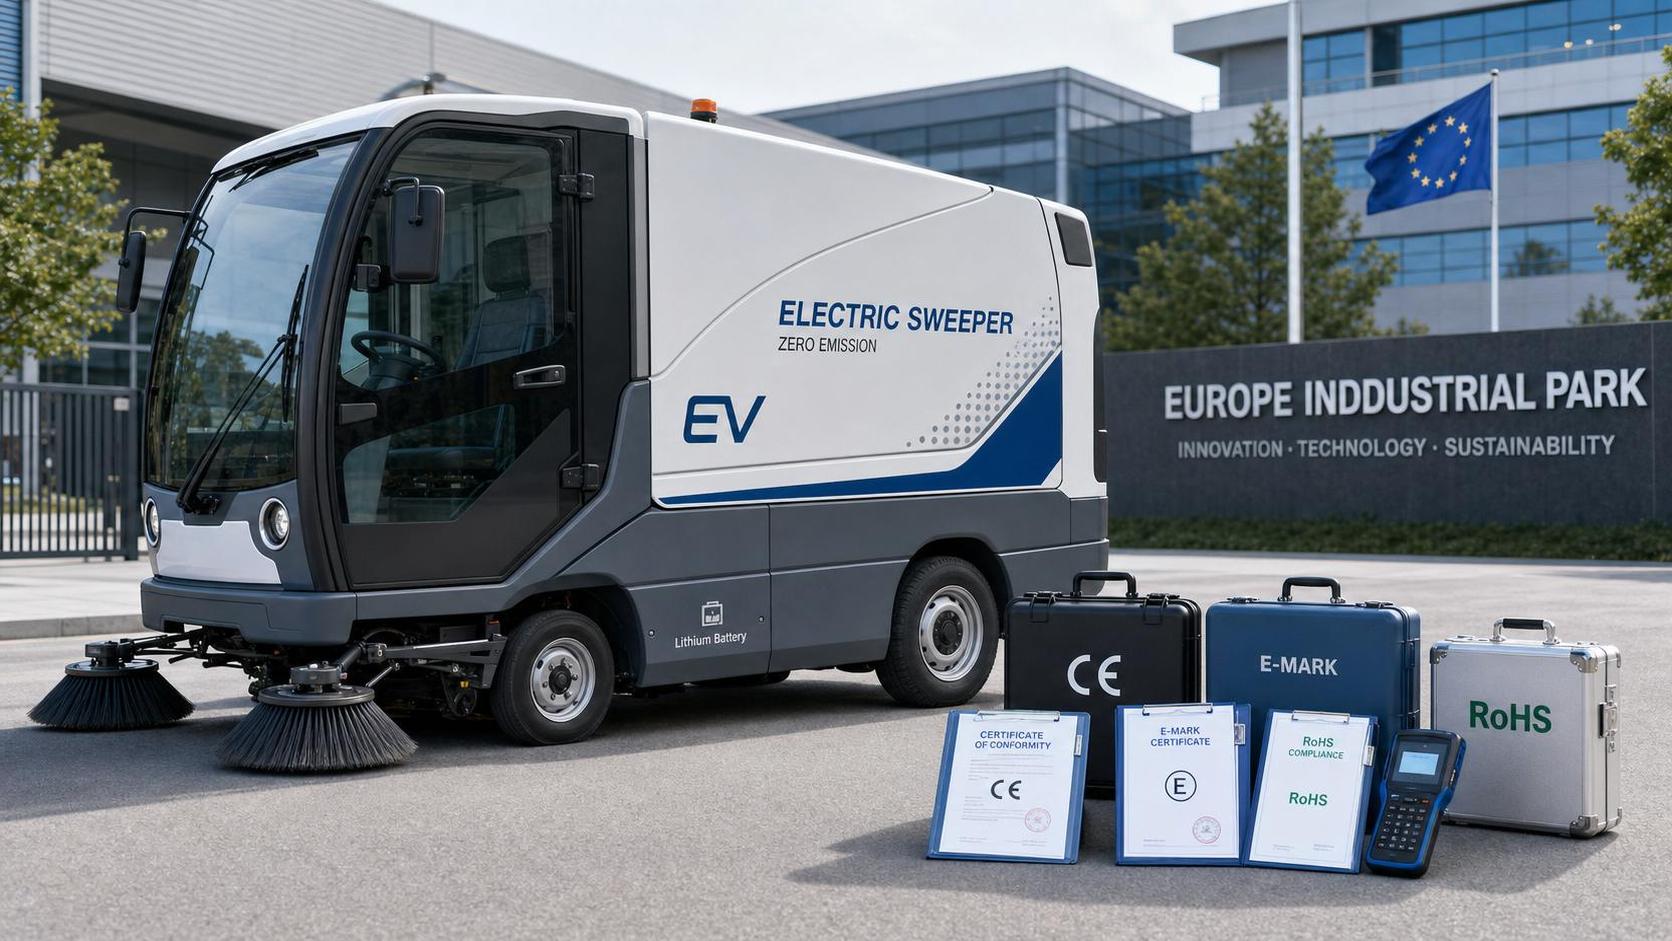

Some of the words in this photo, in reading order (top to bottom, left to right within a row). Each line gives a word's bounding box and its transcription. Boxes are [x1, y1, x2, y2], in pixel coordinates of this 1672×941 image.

[778, 300, 900, 330] ELECTRIC
[907, 306, 1014, 335] SWEEPER
[778, 337, 815, 352] ZERO
[819, 337, 877, 353] EMISSION
[1164, 381, 1293, 420] EUROPE
[1304, 373, 1537, 416] INDDUSTRIAL
[1546, 367, 1648, 409] PARK
[683, 395, 767, 444] EV
[1178, 440, 1283, 459] INNOVATION
[1297, 438, 1427, 457] TECHNOLOGY
[1444, 434, 1615, 457] SUSTAINABILITY
[674, 635, 711, 648] Lithium
[714, 632, 747, 644] Battery
[1260, 655, 1338, 676] E-MARK
[1067, 654, 1122, 697] CE
[1469, 700, 1552, 735] RoHS
[980, 730, 1044, 740] CERTIFICATE
[1160, 726, 1201, 736] E-MARK
[975, 740, 987, 749] OF
[989, 740, 1052, 750] CONFORMITY
[1150, 737, 1211, 747] CERTIFICATE
[1302, 736, 1334, 748] RoHS
[1288, 748, 1344, 760] COMPLIANCE
[990, 779, 1022, 800] CE
[1288, 791, 1328, 806] RoHS
